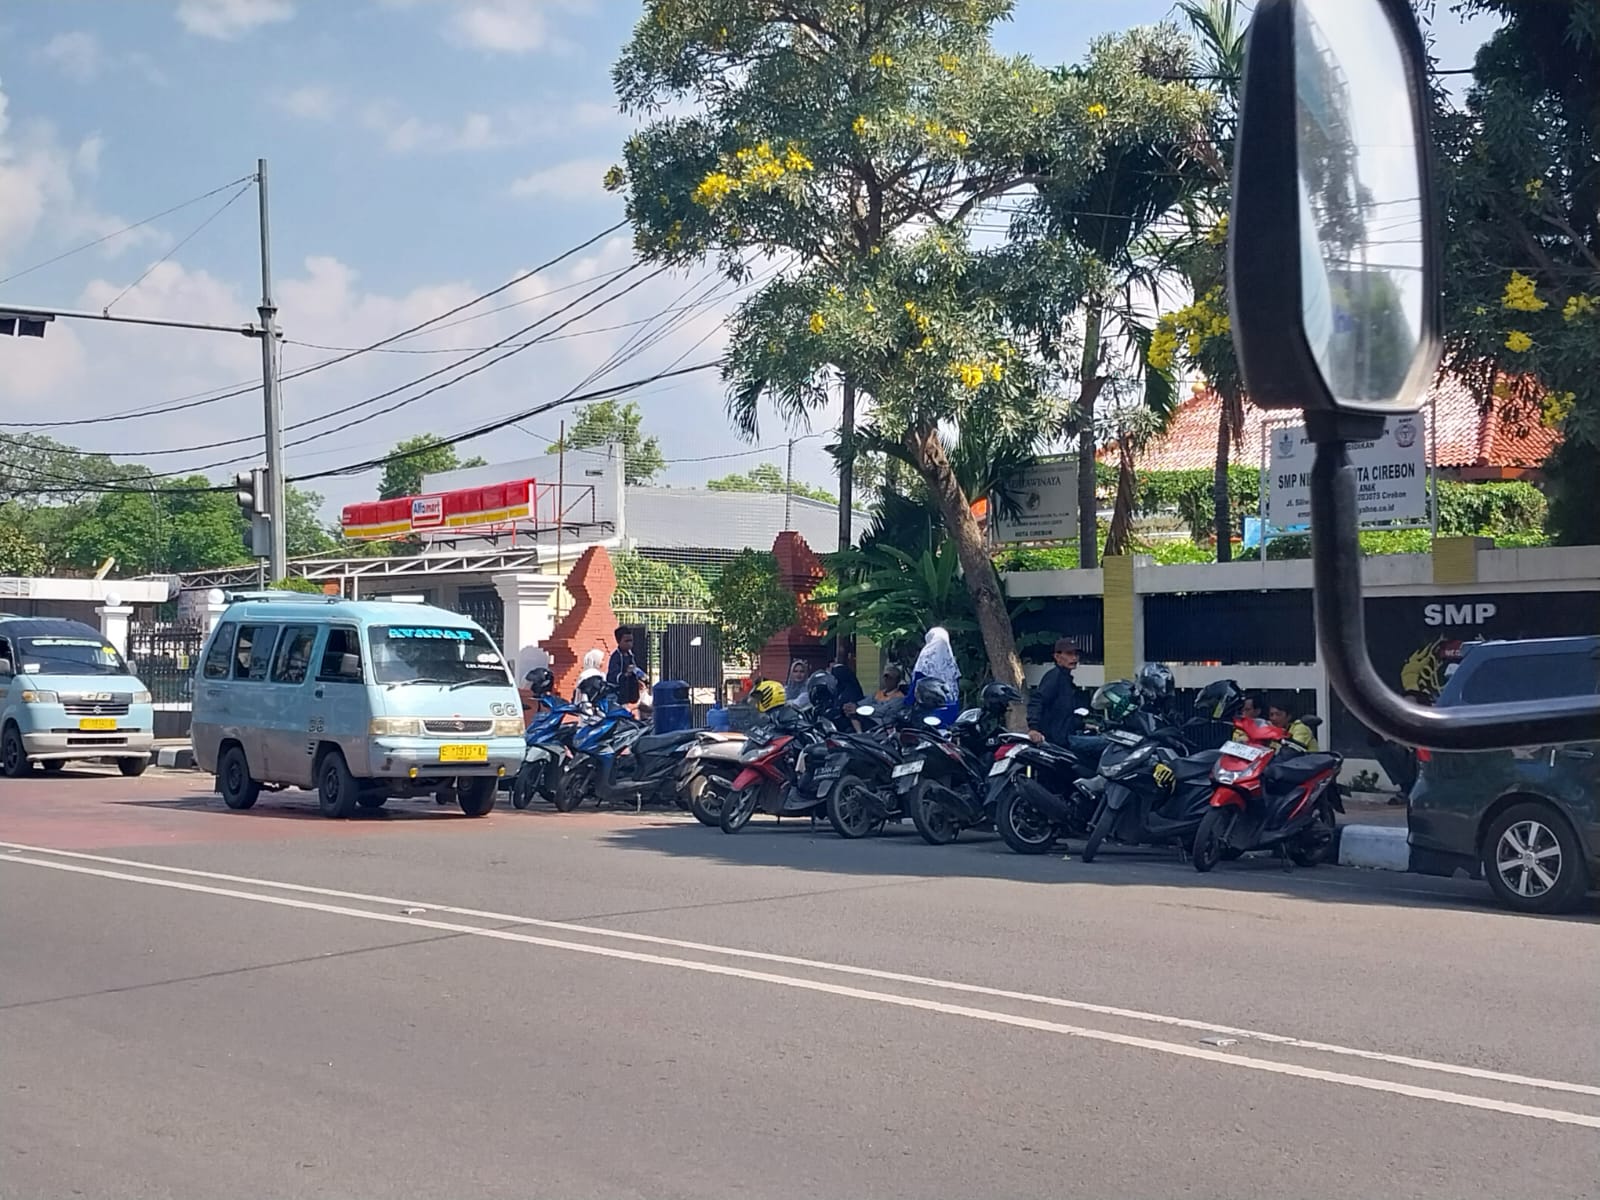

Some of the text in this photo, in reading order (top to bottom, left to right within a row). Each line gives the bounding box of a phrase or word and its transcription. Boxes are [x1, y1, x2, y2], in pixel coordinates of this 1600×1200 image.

[1278, 474, 1297, 489] SMP
[1357, 467, 1370, 482] TA
[1372, 462, 1415, 480] CIREBON
[414, 500, 440, 514] Alfamart
[1424, 604, 1496, 625] SMP
[388, 628, 475, 641] AVATAR
[489, 702, 518, 717] GG
